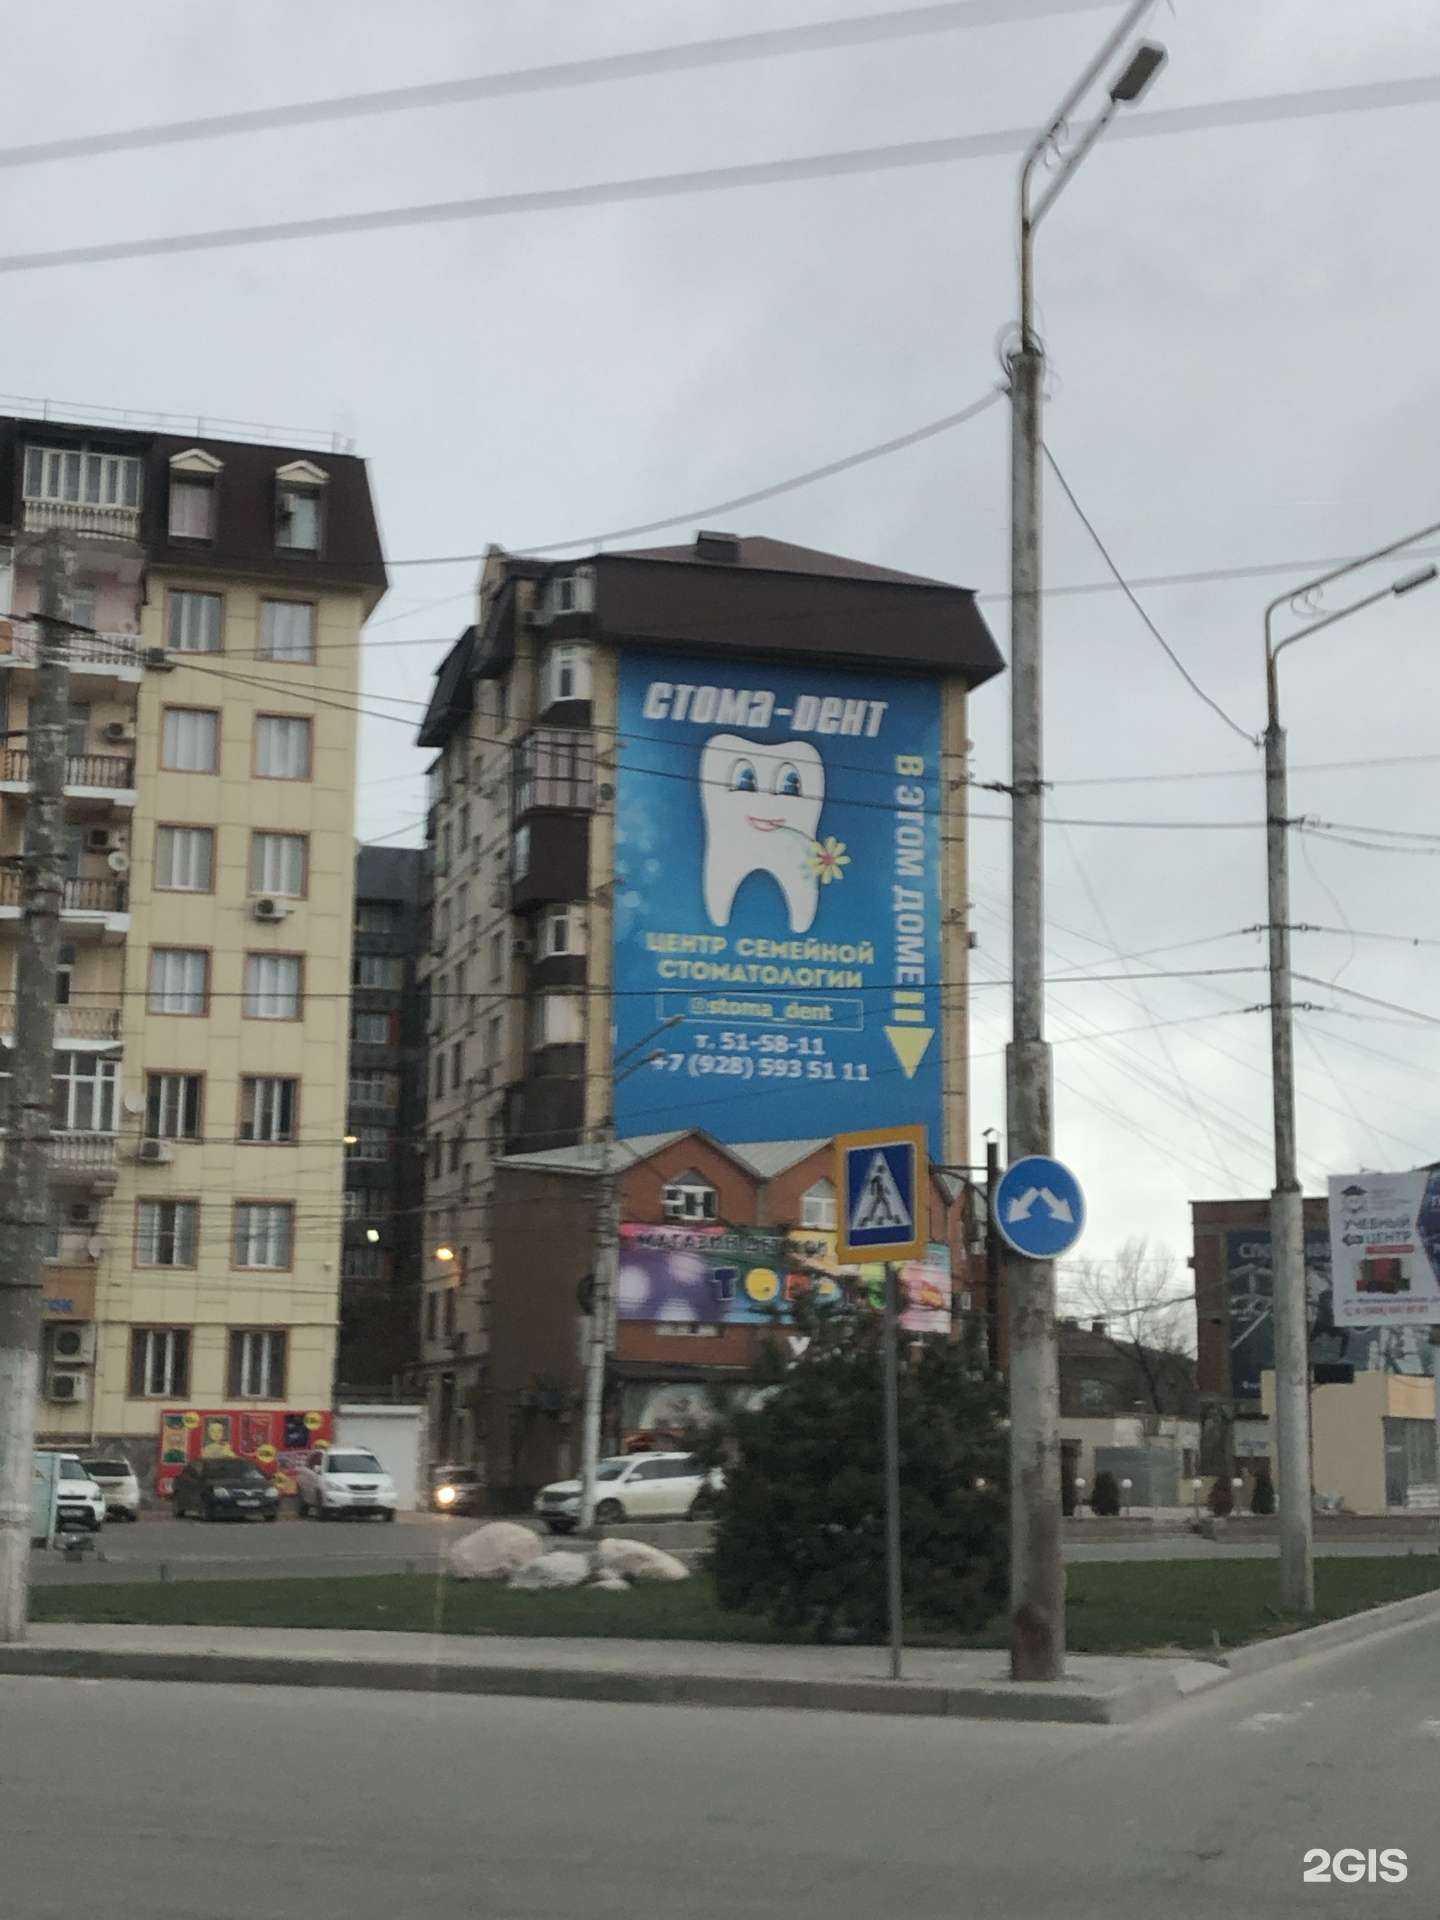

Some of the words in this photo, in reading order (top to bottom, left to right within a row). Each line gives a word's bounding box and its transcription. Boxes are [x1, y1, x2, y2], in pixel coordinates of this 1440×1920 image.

[896, 755, 924, 776] В
[896, 785, 925, 877] ЭТОМ
[646, 932, 728, 955] ЦЕНТР
[735, 938, 875, 965] СЕМЕЙНОЙ
[893, 885, 925, 985] ДОМЕ
[656, 959, 863, 988] СТОМАТОЛОГИИ
[689, 997, 834, 1022] @stoma_dent
[720, 1032, 826, 1056] 51-58-11
[651, 1052, 685, 1073] +7
[687, 1053, 754, 1079] (928)
[758, 1057, 802, 1079] 593
[806, 1060, 836, 1080] 51
[843, 1063, 870, 1082] 11
